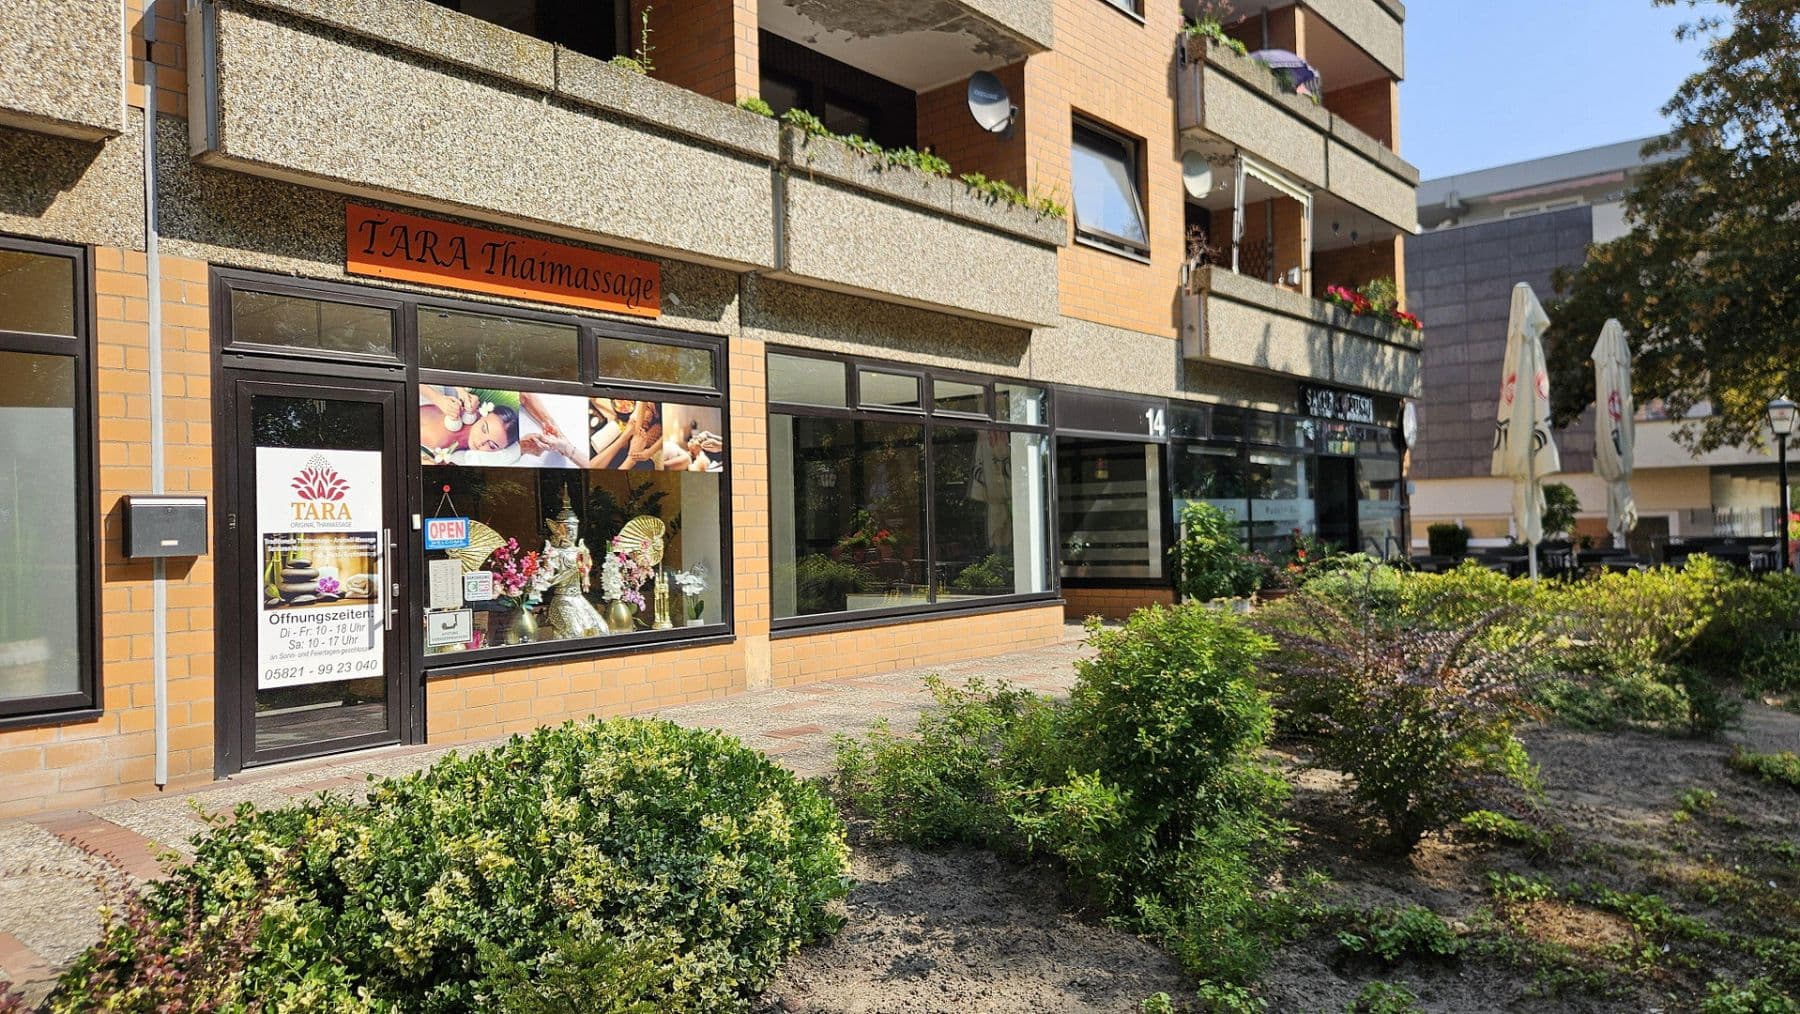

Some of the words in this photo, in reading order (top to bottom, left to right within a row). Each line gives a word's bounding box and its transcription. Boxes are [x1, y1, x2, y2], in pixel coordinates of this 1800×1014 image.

[358, 217, 472, 271] TARA
[481, 240, 655, 309] Thaimassage
[1145, 407, 1166, 437] 14
[291, 502, 352, 520] TARA
[430, 521, 464, 539] OPEN
[269, 608, 375, 626] Öffnungszeiten:
[280, 628, 291, 638] Di
[316, 625, 328, 636] 10
[337, 624, 347, 634] 18
[350, 622, 366, 633] Uhr
[289, 640, 304, 650] Sa:
[309, 639, 320, 648] 10
[330, 637, 339, 646] 17
[342, 635, 359, 645] Uhr
[265, 667, 304, 681] 05821
[318, 664, 333, 675] 99
[337, 662, 352, 673] 23
[355, 660, 378, 671] 040
